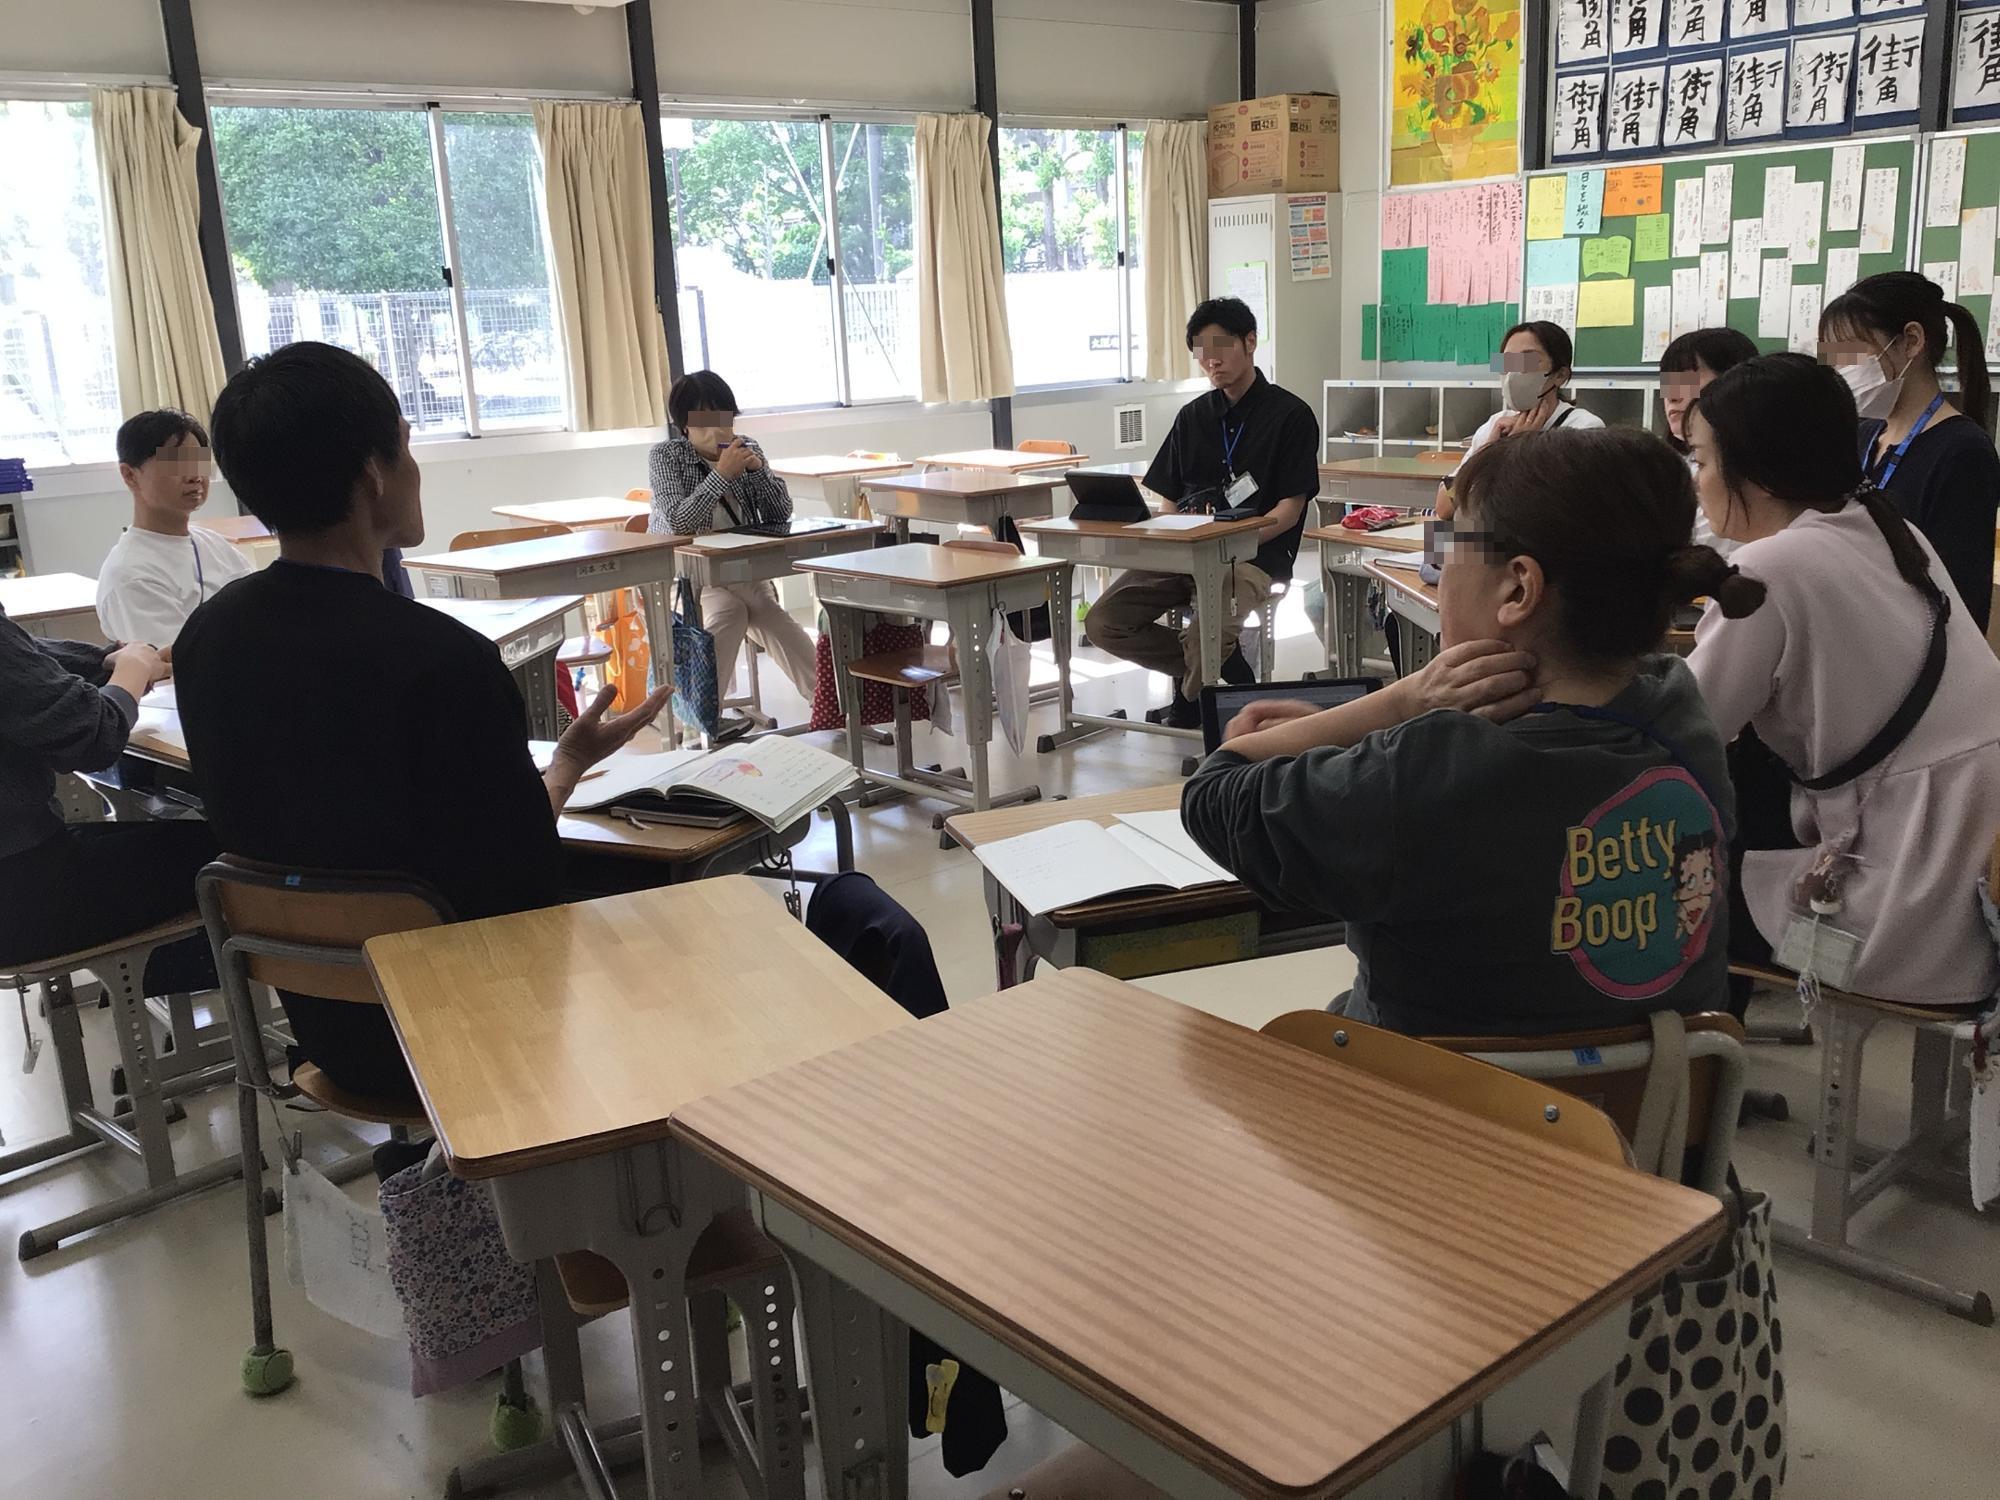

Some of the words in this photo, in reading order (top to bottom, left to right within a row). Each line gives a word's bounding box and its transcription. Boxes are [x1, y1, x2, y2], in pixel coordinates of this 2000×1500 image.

[1625, 0, 1648, 47] 角
[1680, 0, 1711, 42] 角
[1733, 57, 1783, 130] 街角
[1806, 51, 1849, 122] 街角
[1859, 33, 1920, 105] 街角
[1566, 80, 1600, 150] 街角
[1620, 75, 1660, 146] 街角
[1675, 67, 1714, 142] 街角
[1567, 817, 1676, 886] Betty
[1553, 893, 1657, 951] Boop
